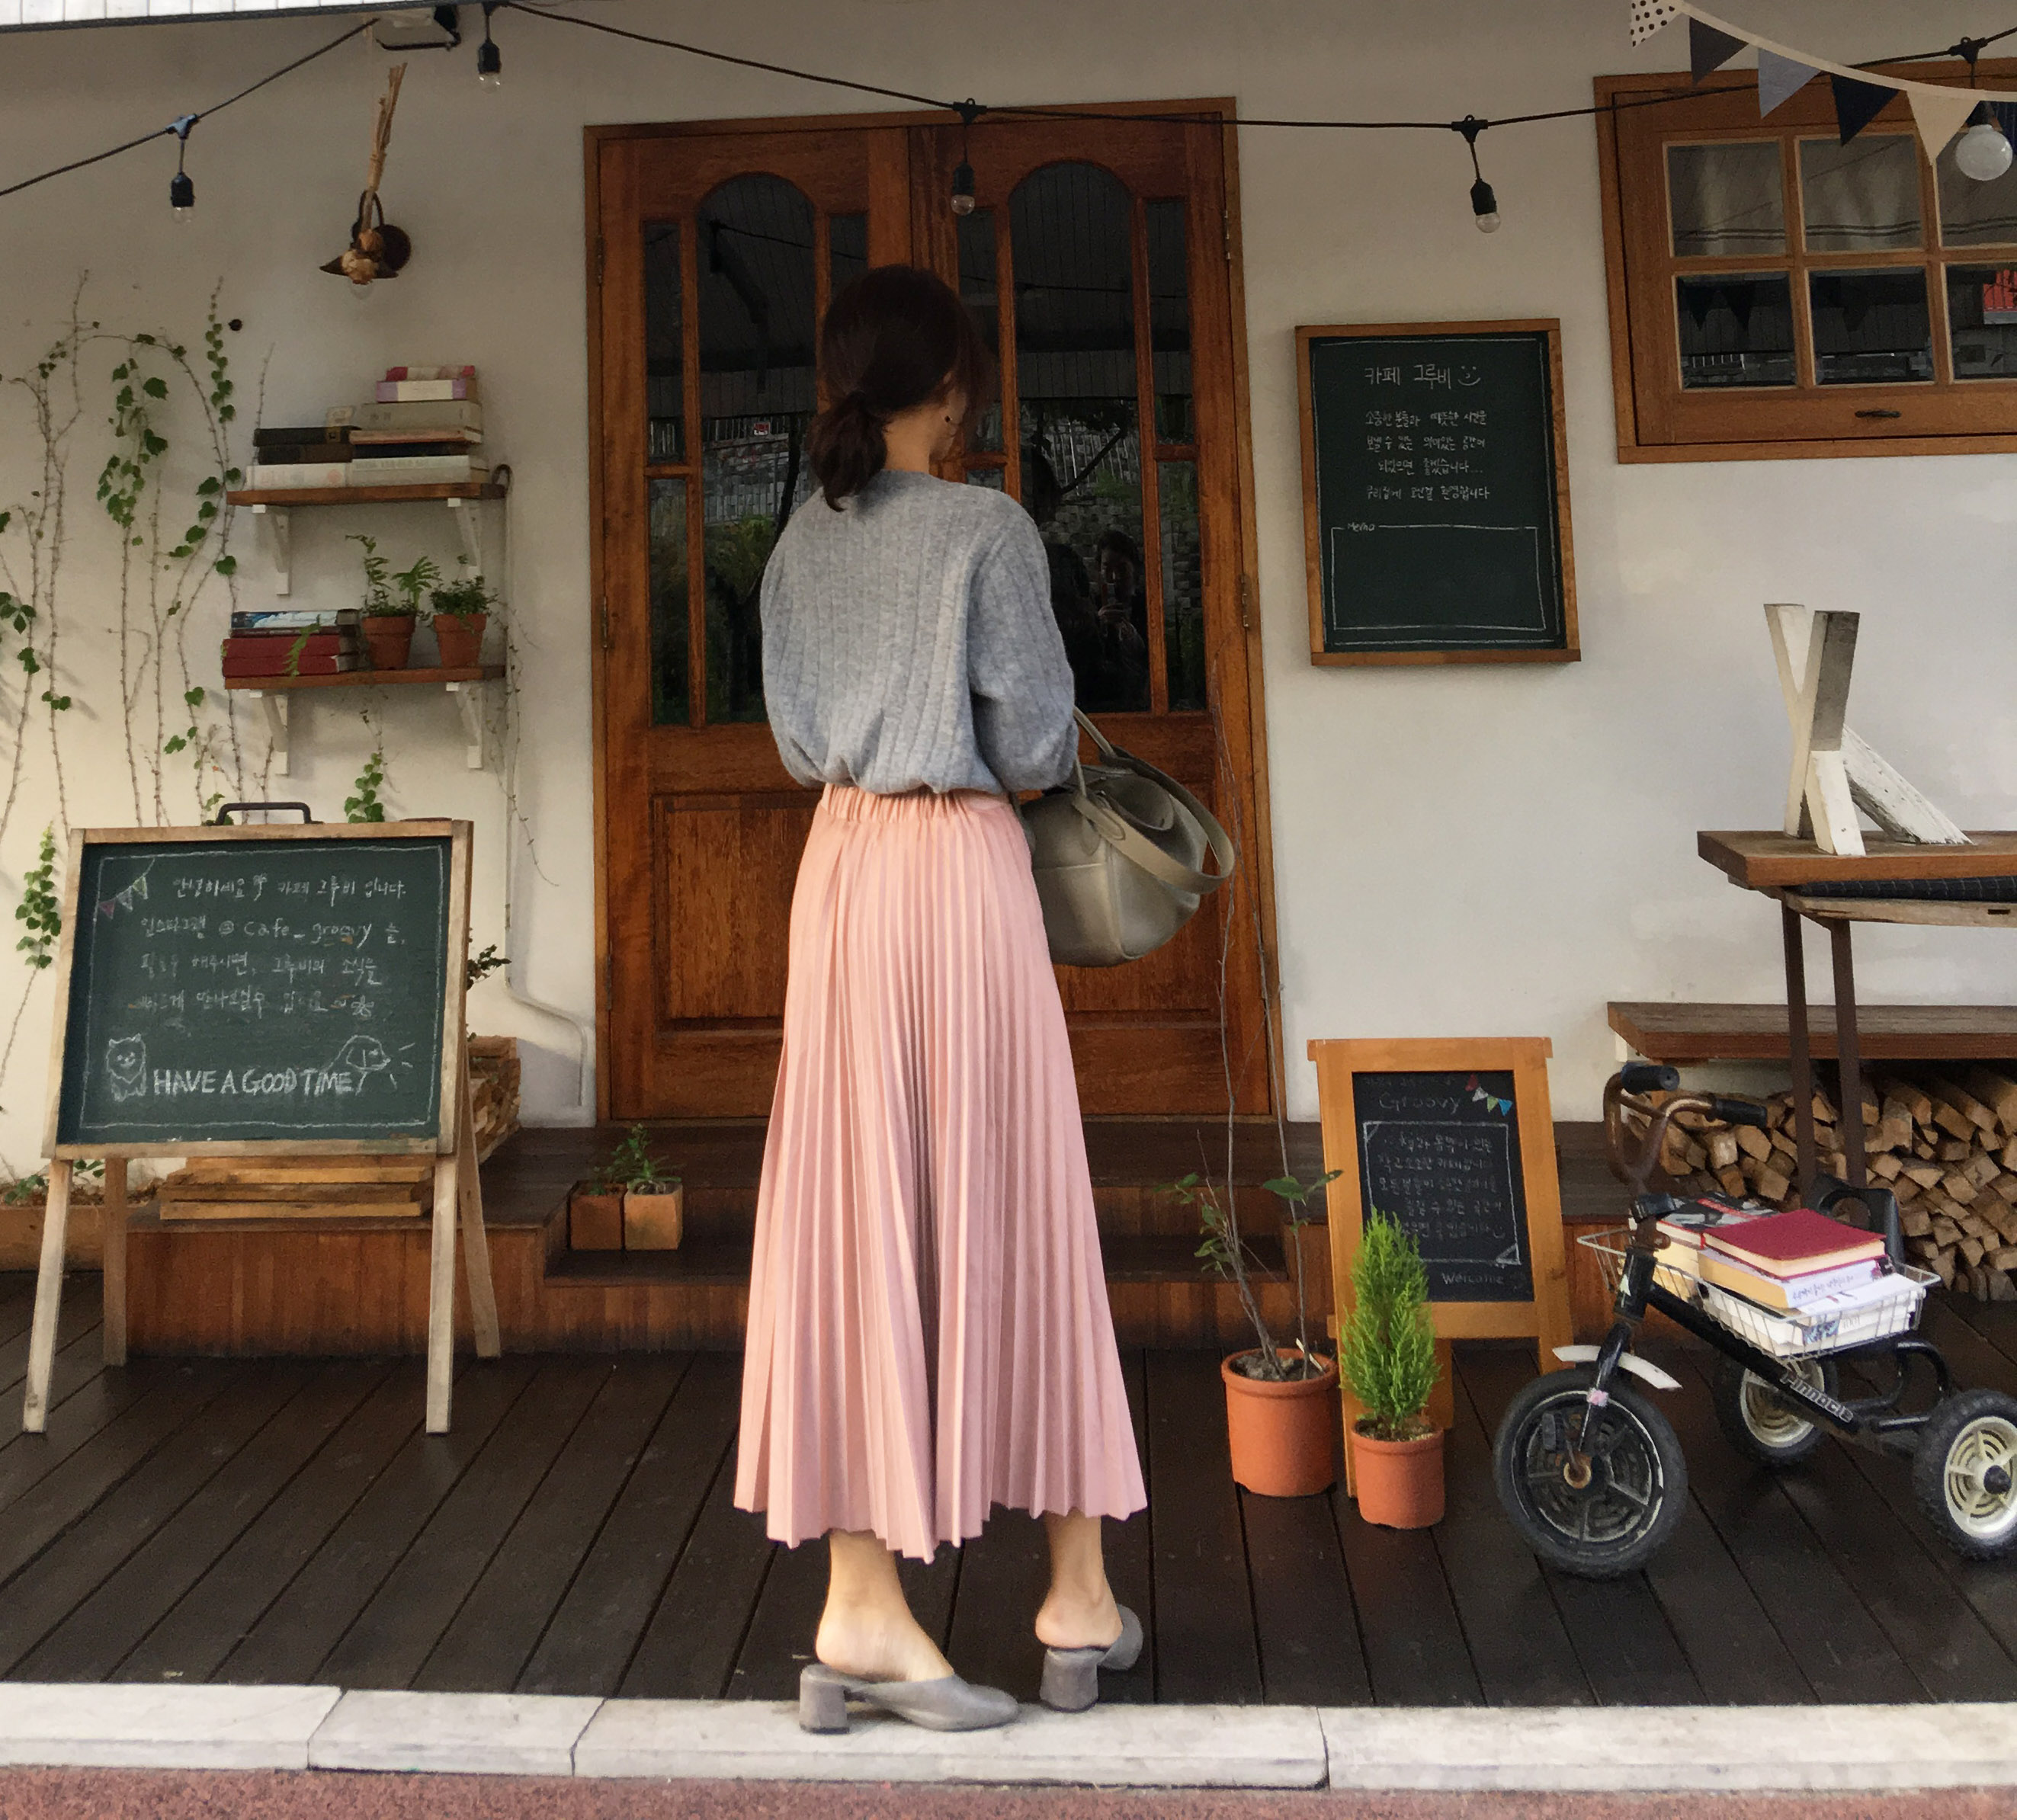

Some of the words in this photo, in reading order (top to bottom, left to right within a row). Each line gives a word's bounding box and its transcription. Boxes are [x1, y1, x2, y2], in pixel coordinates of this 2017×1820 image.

[1364, 366, 1401, 386] 카페
[1413, 363, 1452, 390] 그루비
[1364, 410, 1393, 427] 소중한
[1394, 409, 1422, 428] 분들과
[1430, 409, 1459, 427] 따뜻한
[1463, 409, 1489, 426] 시간을
[1366, 434, 1383, 453] 보낼
[1384, 435, 1393, 451] 수
[1398, 434, 1414, 451] 있는
[1440, 485, 1490, 502] 환영합니다
[172, 877, 245, 899] 안녕하세요
[277, 880, 309, 896] 카페
[316, 875, 356, 907] 그루비
[140, 915, 207, 940] 인스타그램
[271, 953, 325, 984] 그루비의
[342, 956, 383, 986] 소식을
[153, 1069, 218, 1096] HAVE
[220, 1069, 239, 1095] A
[242, 1067, 297, 1097] GOOD
[299, 1067, 354, 1097] TIME
